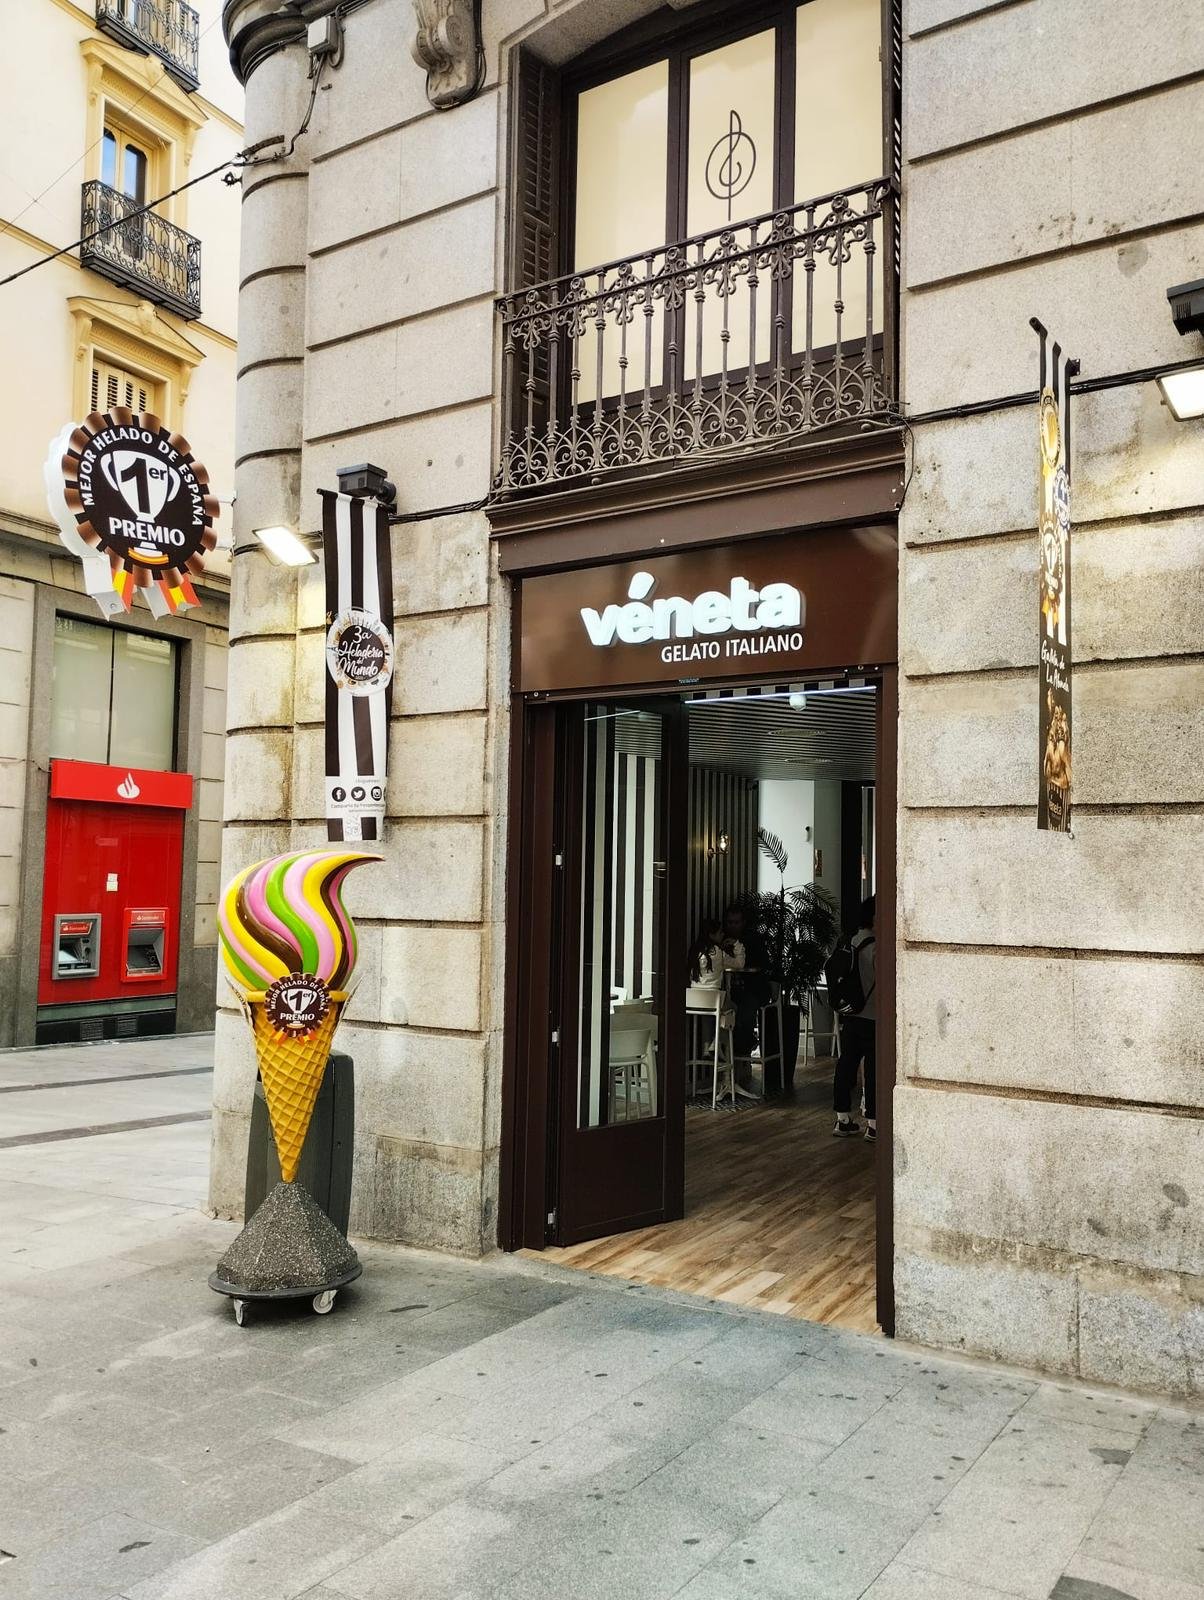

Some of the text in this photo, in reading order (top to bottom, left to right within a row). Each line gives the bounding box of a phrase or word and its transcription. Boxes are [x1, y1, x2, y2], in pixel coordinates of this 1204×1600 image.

[79, 427, 206, 526] MEJOR HELADO DE ESPAÑA
[120, 457, 168, 515] 1er
[108, 516, 186, 547] PREMIO
[580, 571, 803, 646] véneta
[661, 632, 803, 663] GELATO ITALIANO
[338, 657, 379, 677] Mundo
[270, 989, 280, 1010] MEJOR
[280, 980, 308, 990] HELADO
[309, 982, 319, 990] DE
[289, 990, 312, 1011] 1er
[280, 1012, 315, 1021] PREMIO
